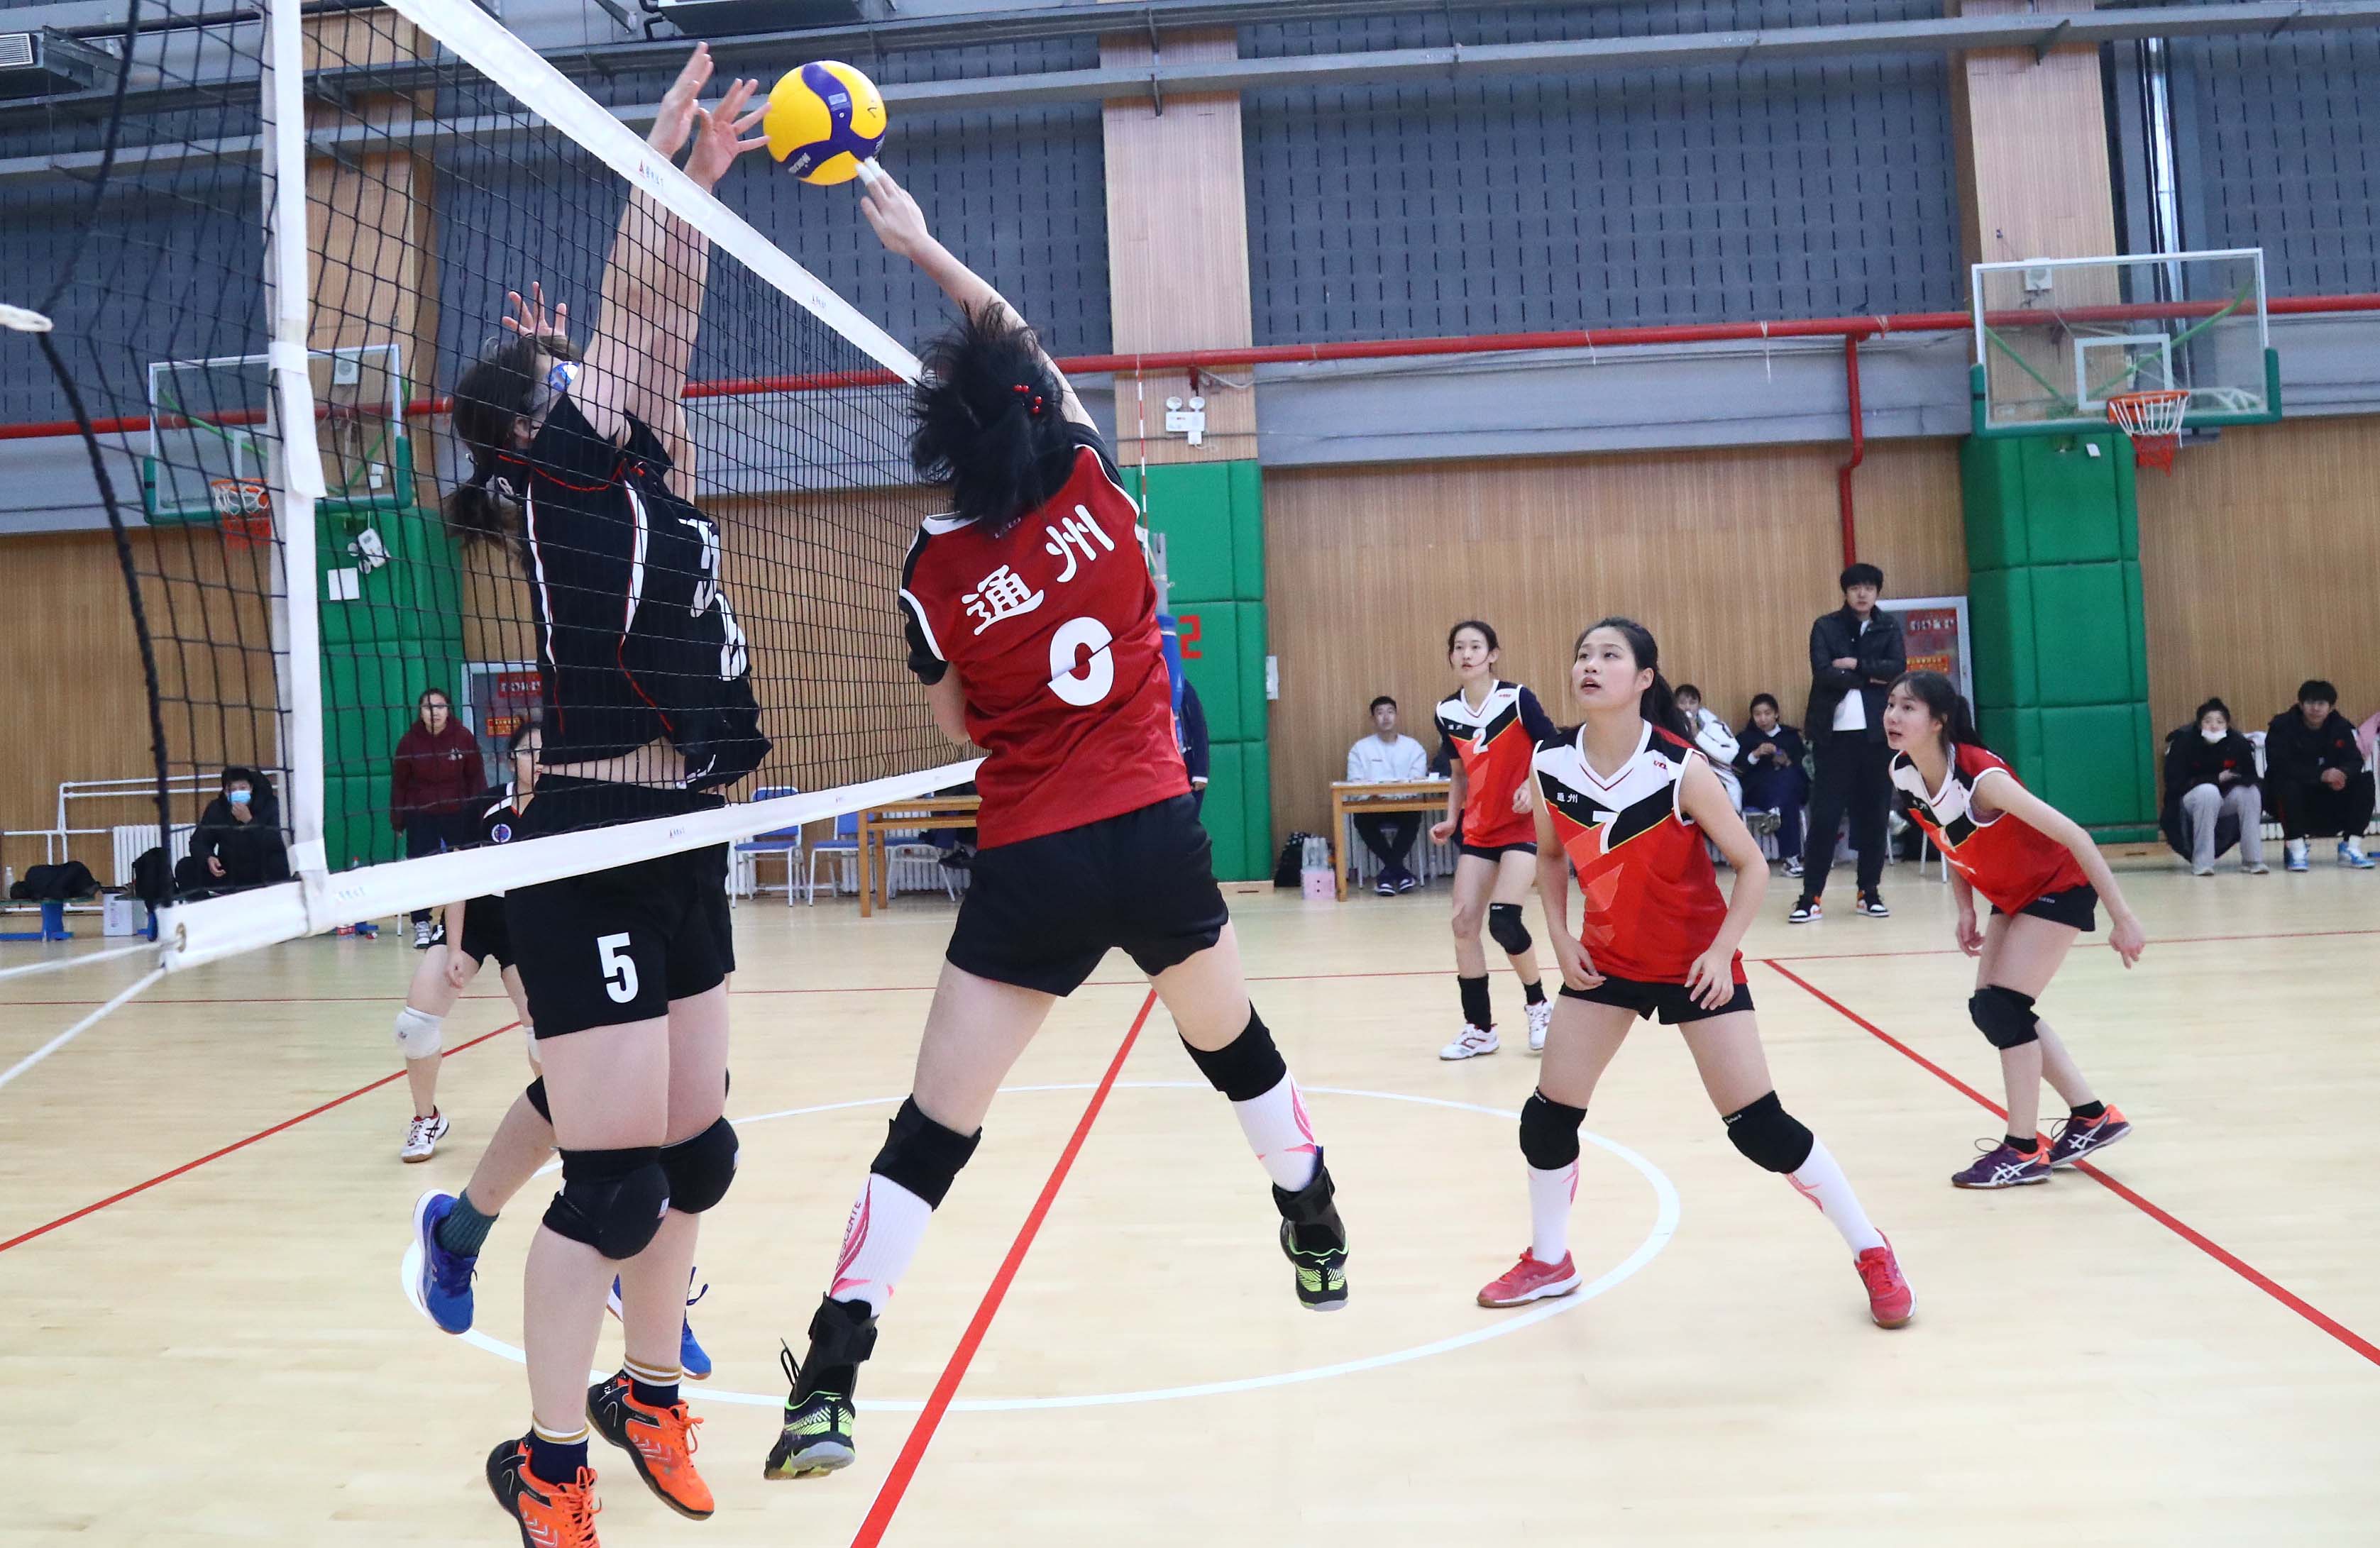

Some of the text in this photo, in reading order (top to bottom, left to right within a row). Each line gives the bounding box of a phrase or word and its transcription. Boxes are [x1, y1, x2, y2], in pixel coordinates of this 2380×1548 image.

[962, 504, 1115, 636] 通州
[1179, 614, 1203, 659] 2
[1472, 728, 1489, 755] 2
[1592, 810, 1620, 854] 7
[596, 931, 639, 1004] 5
